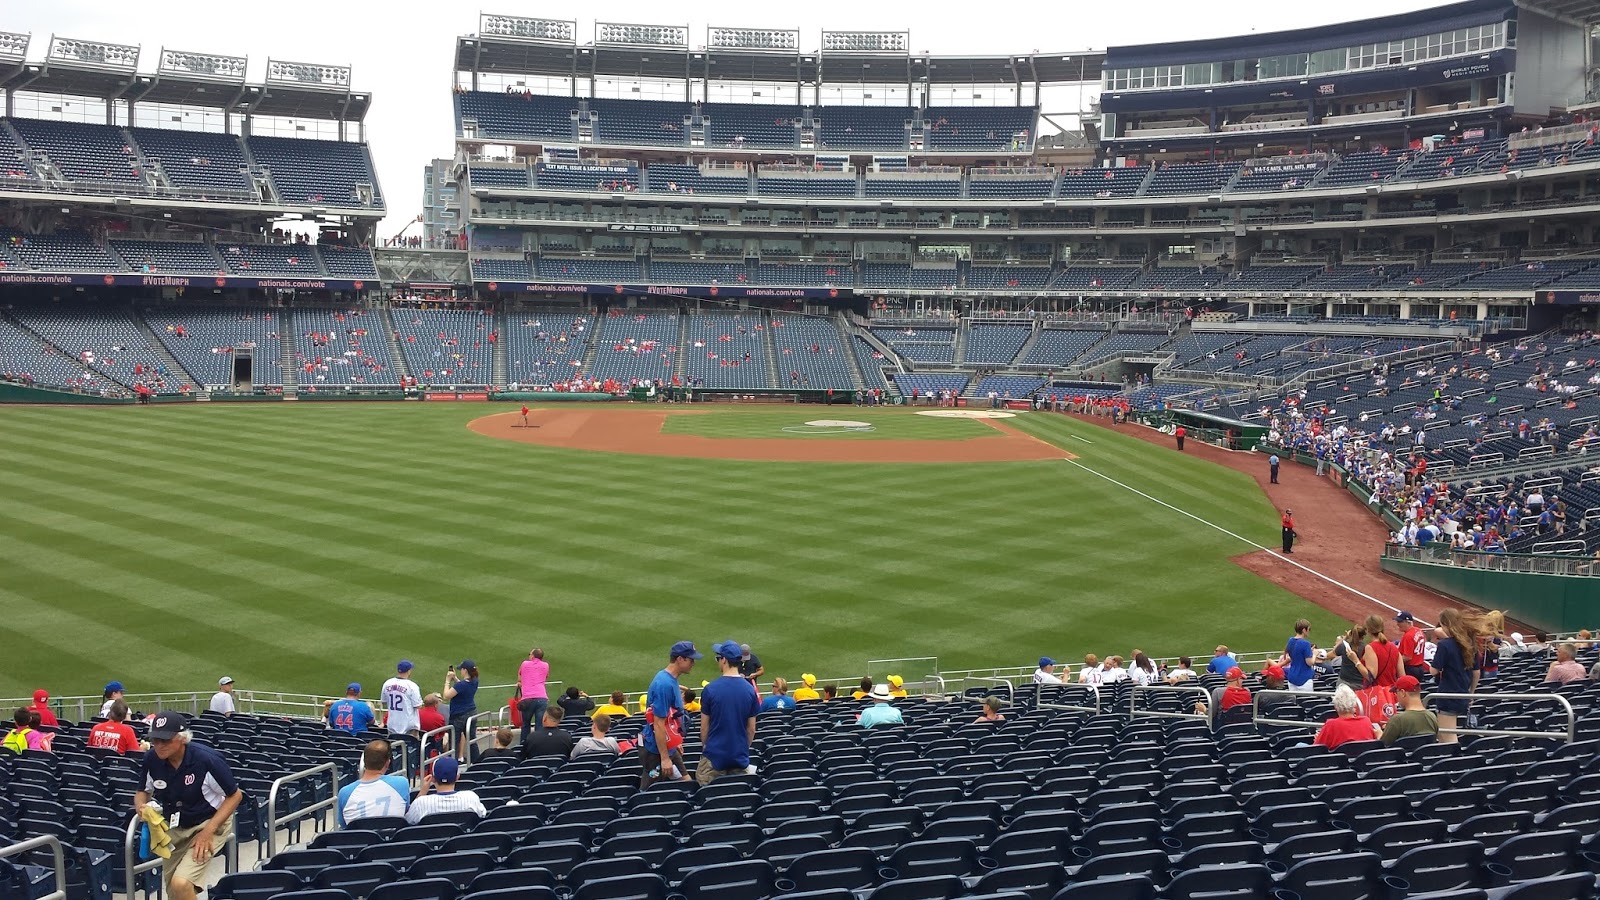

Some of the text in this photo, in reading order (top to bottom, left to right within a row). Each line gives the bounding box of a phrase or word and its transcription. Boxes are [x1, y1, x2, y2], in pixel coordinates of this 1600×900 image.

[1, 274, 72, 284] nationals.com/vote
[258, 280, 326, 289] nationals.com/vote
[526, 284, 588, 293] nationals.com/vote
[746, 289, 805, 297] nationals.com/vote
[1413, 638, 1425, 656] 47
[1092, 673, 1103, 684] 17
[388, 693, 404, 712] 12
[156, 717, 167, 728] W
[335, 713, 354, 730] 44
[104, 731, 121, 739] YOUR
[92, 736, 120, 747] RED
[184, 773, 196, 786] W
[356, 795, 392, 817] 17
